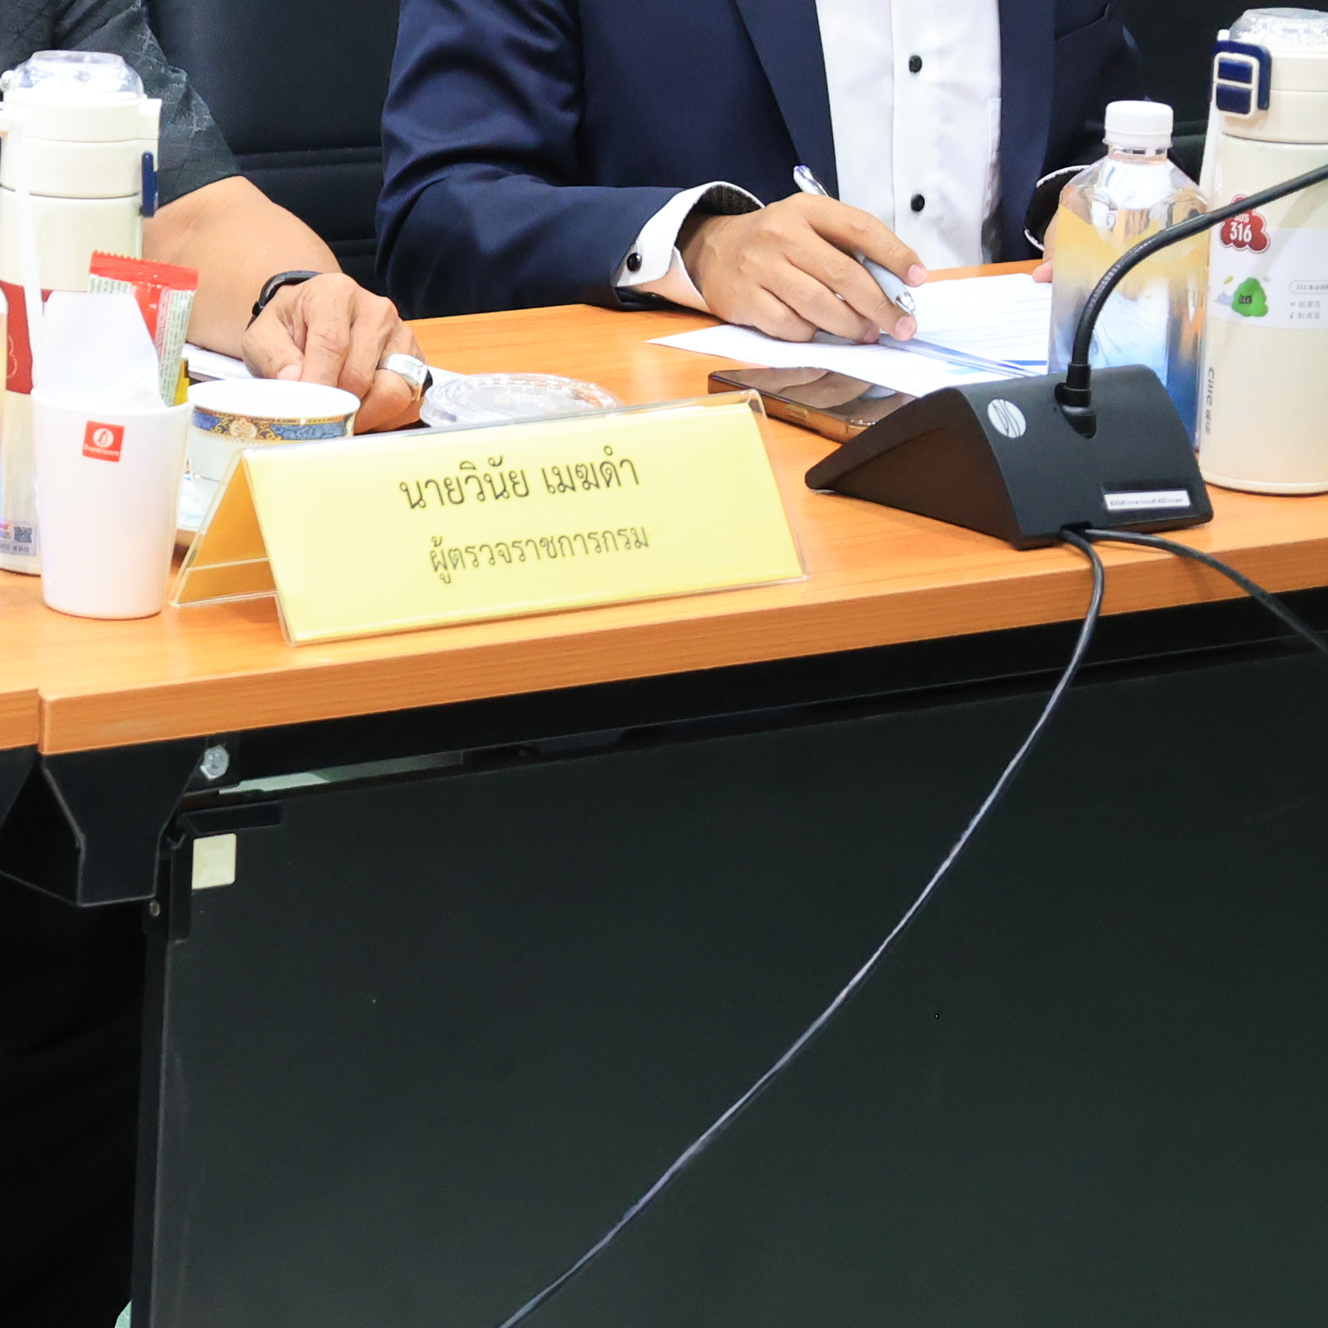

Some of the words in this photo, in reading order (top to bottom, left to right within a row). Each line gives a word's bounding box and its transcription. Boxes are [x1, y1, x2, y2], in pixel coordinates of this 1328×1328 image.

[1229, 222, 1252, 243] 316
[399, 455, 531, 509] นายวินัย
[541, 445, 641, 495] เมฆดำ
[429, 526, 650, 584] ผู้ตรวจราชการกรม
